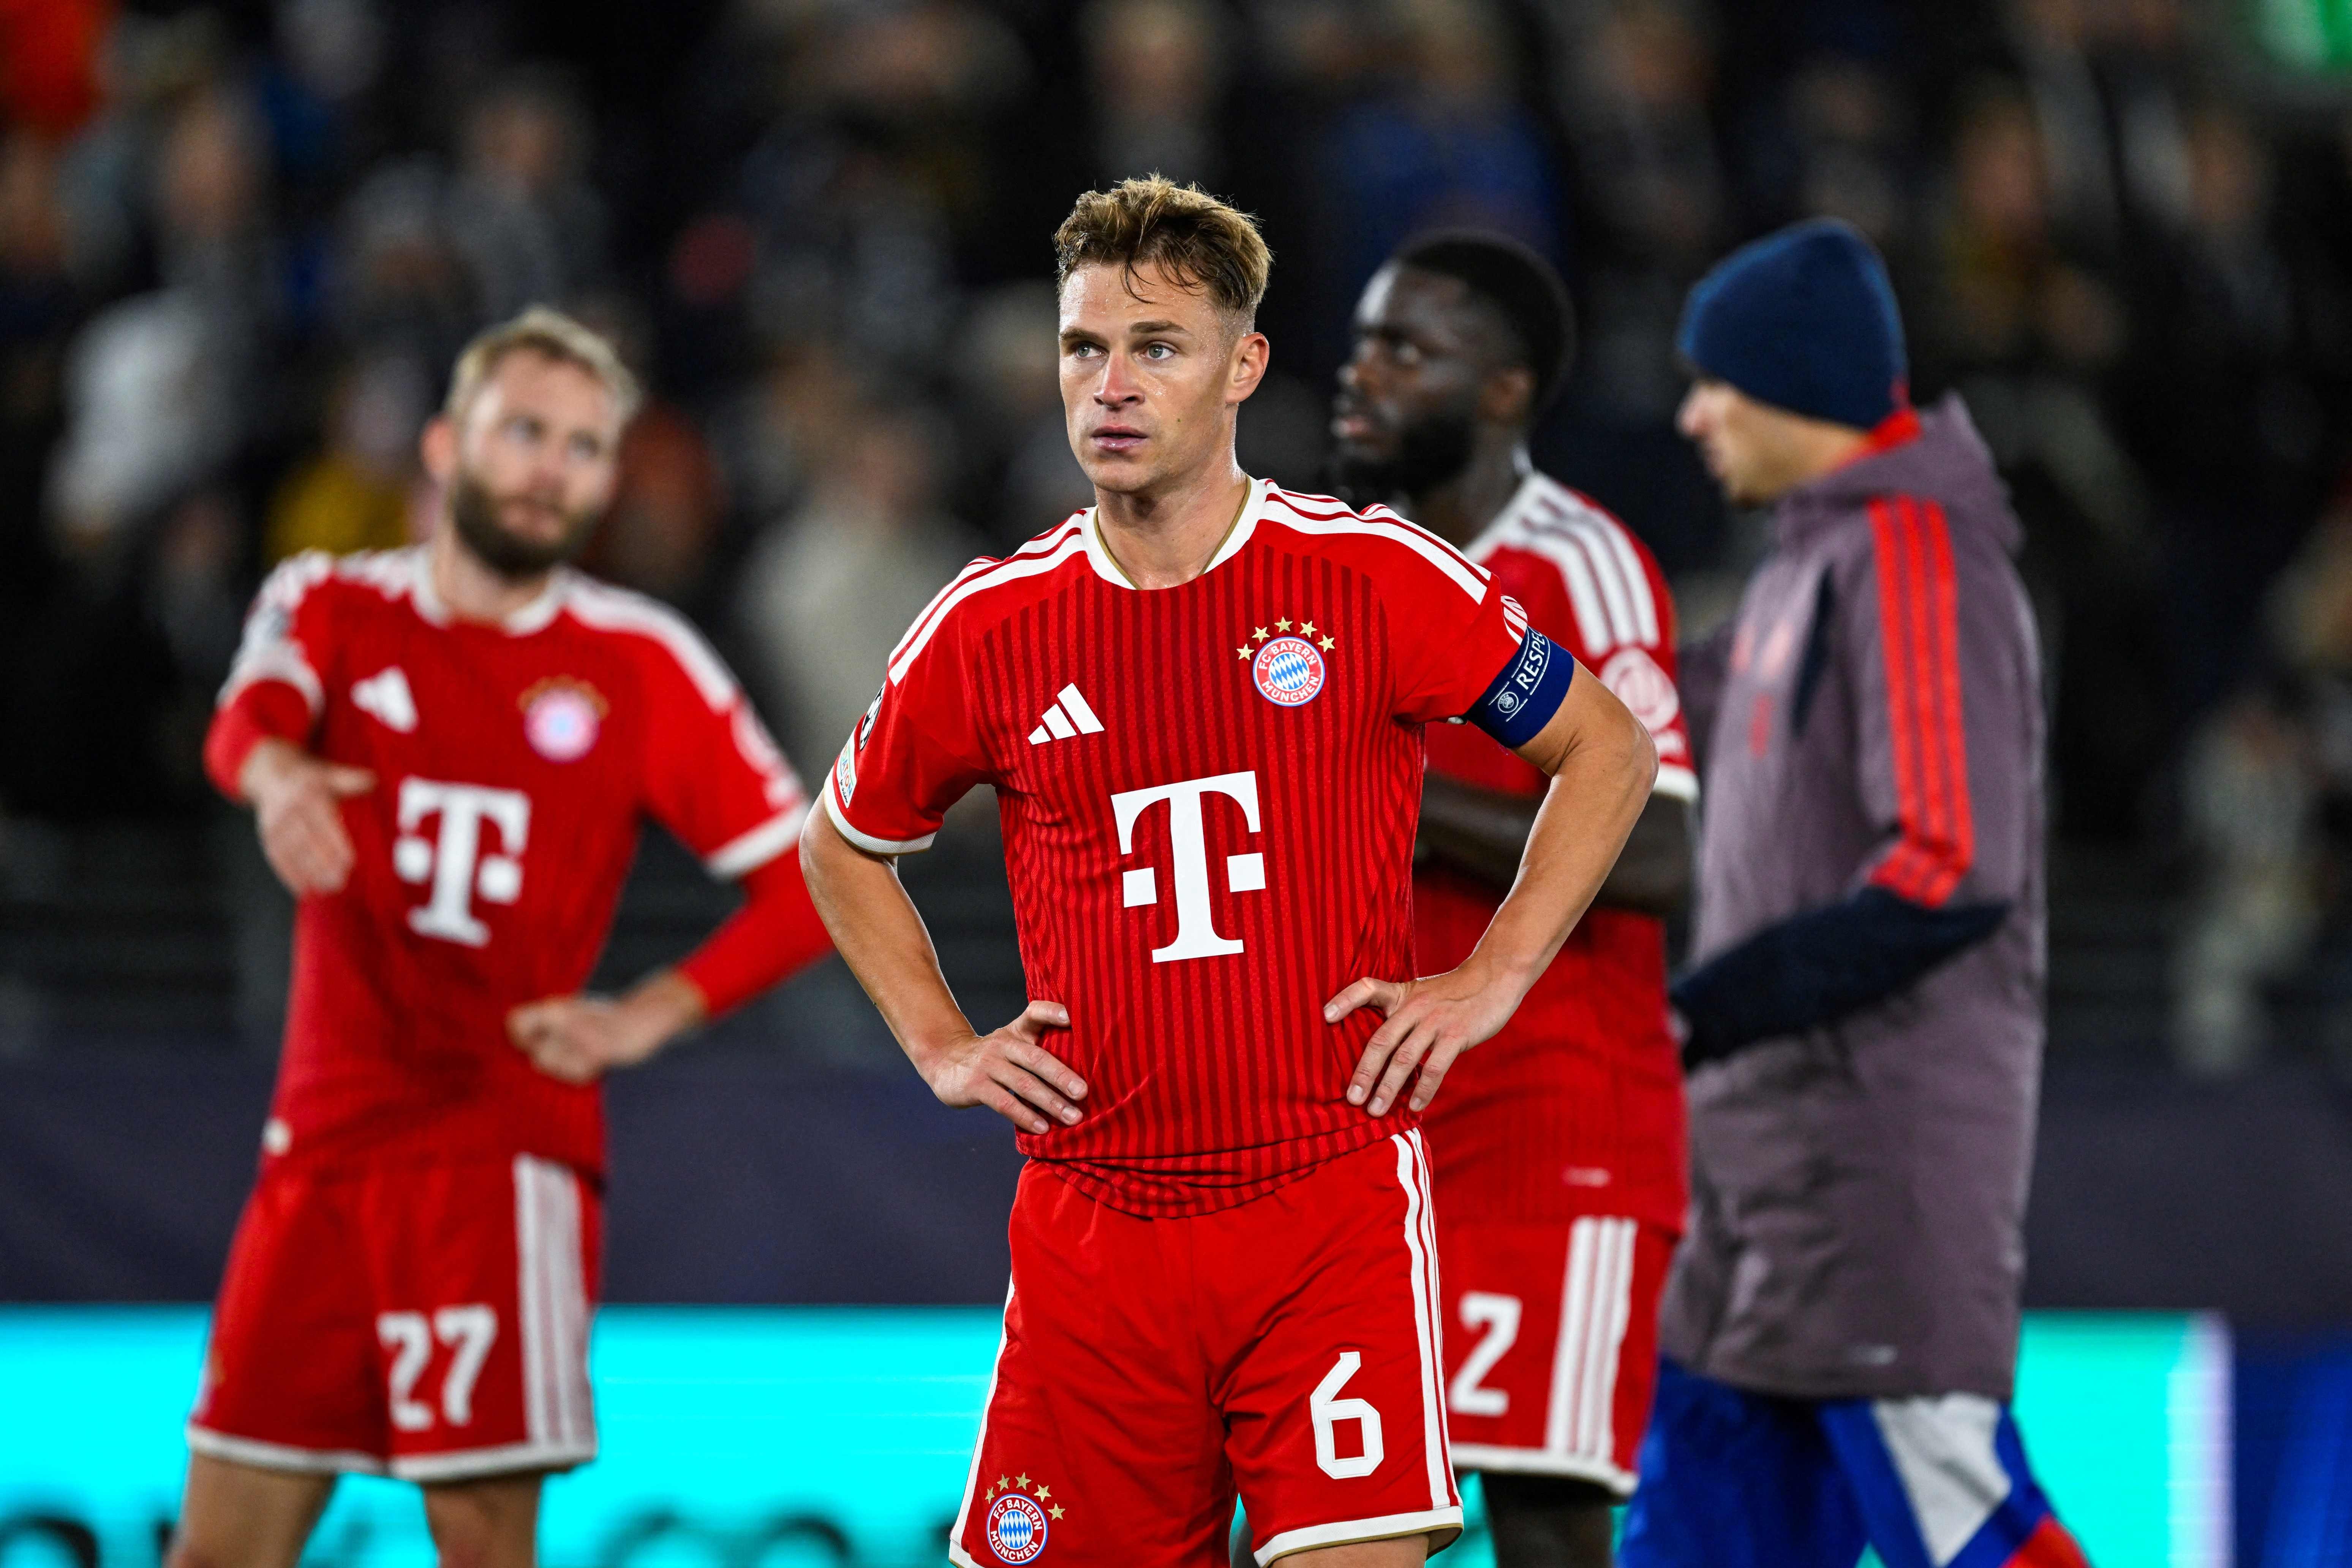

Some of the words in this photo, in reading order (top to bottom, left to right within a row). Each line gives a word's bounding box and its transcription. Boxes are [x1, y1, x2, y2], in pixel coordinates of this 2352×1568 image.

[1259, 653, 1271, 670] FC
[1271, 642, 1317, 665] BAYERN
[1262, 676, 1319, 702] MÜNCHEN
[394, 775, 531, 948] T
[1111, 771, 1266, 963] T
[377, 1304, 499, 1432] 27
[1310, 1351, 1384, 1479] 6
[1449, 1291, 1522, 1417] 2
[990, 1530, 1039, 1560] MÜNCHEN
[993, 1504, 1005, 1520] FC
[1006, 1499, 1043, 1530] BAYERN
